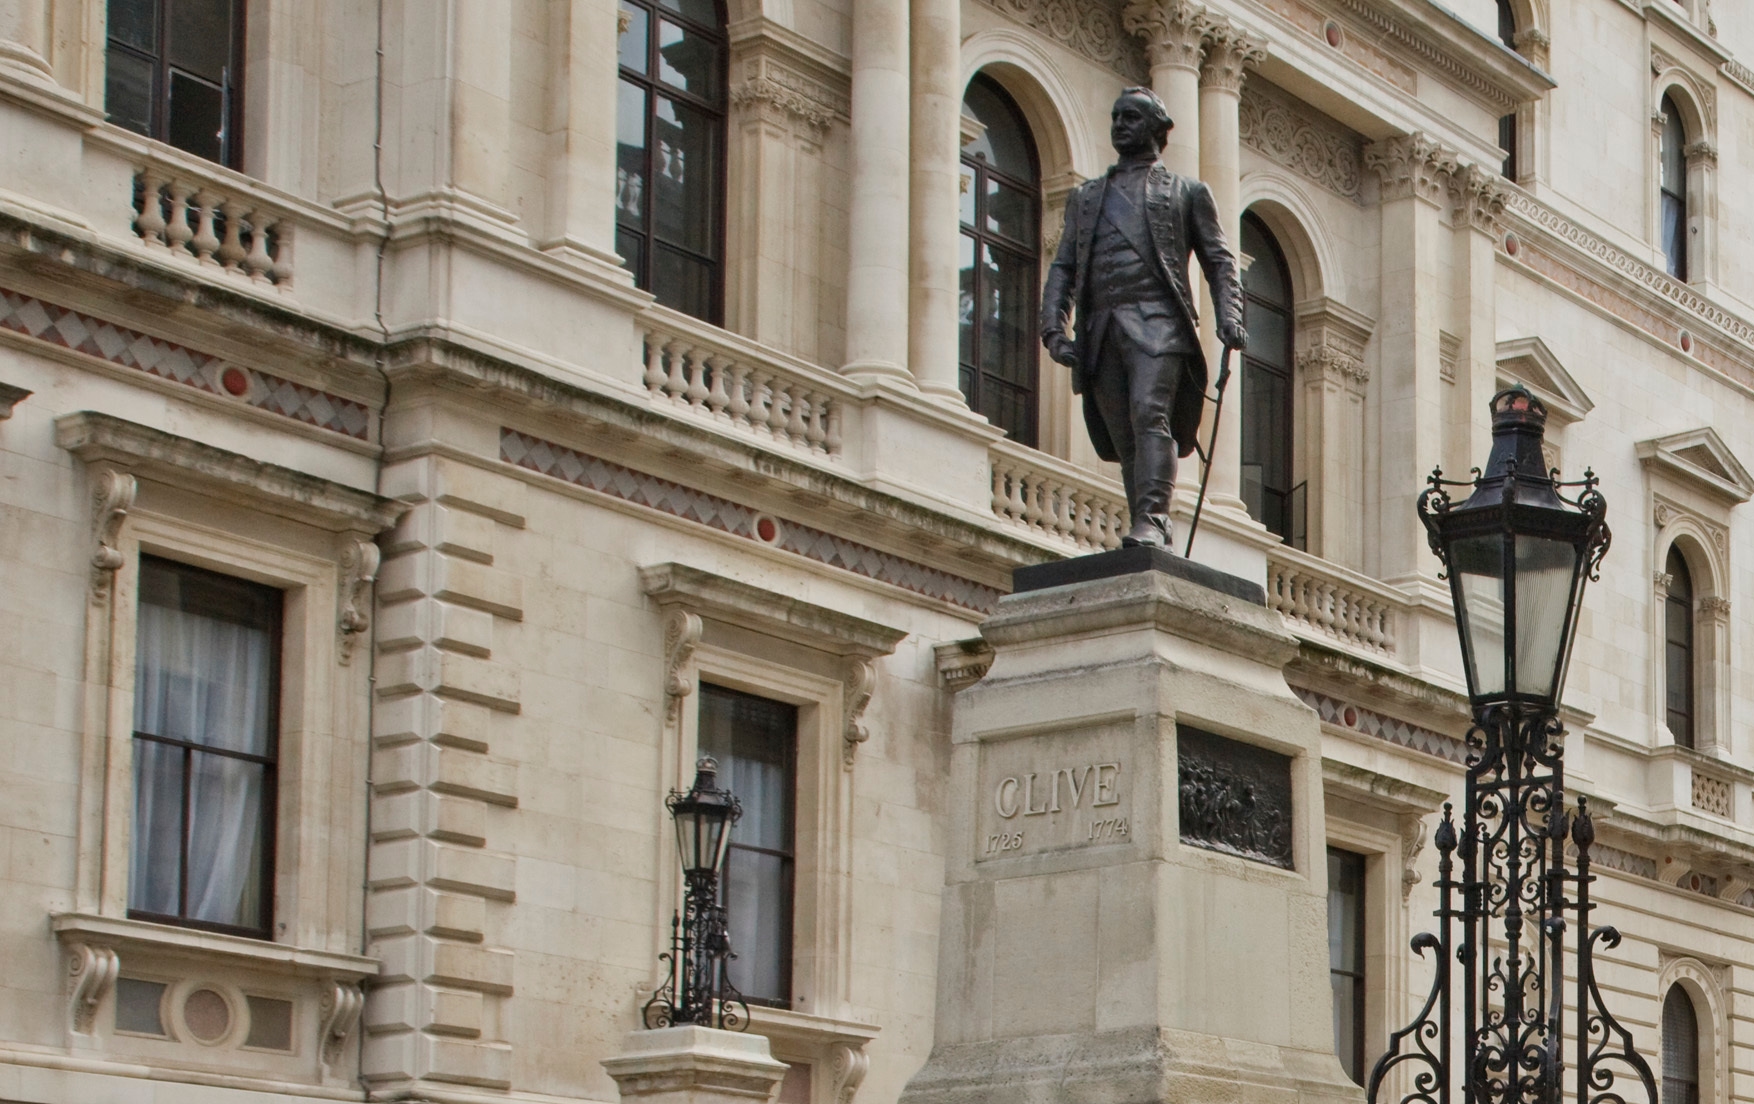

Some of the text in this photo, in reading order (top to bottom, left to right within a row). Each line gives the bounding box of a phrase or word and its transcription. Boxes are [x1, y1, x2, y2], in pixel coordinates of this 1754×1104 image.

[995, 761, 1121, 818] CLIVE
[985, 817, 1130, 854] 1725 1774
